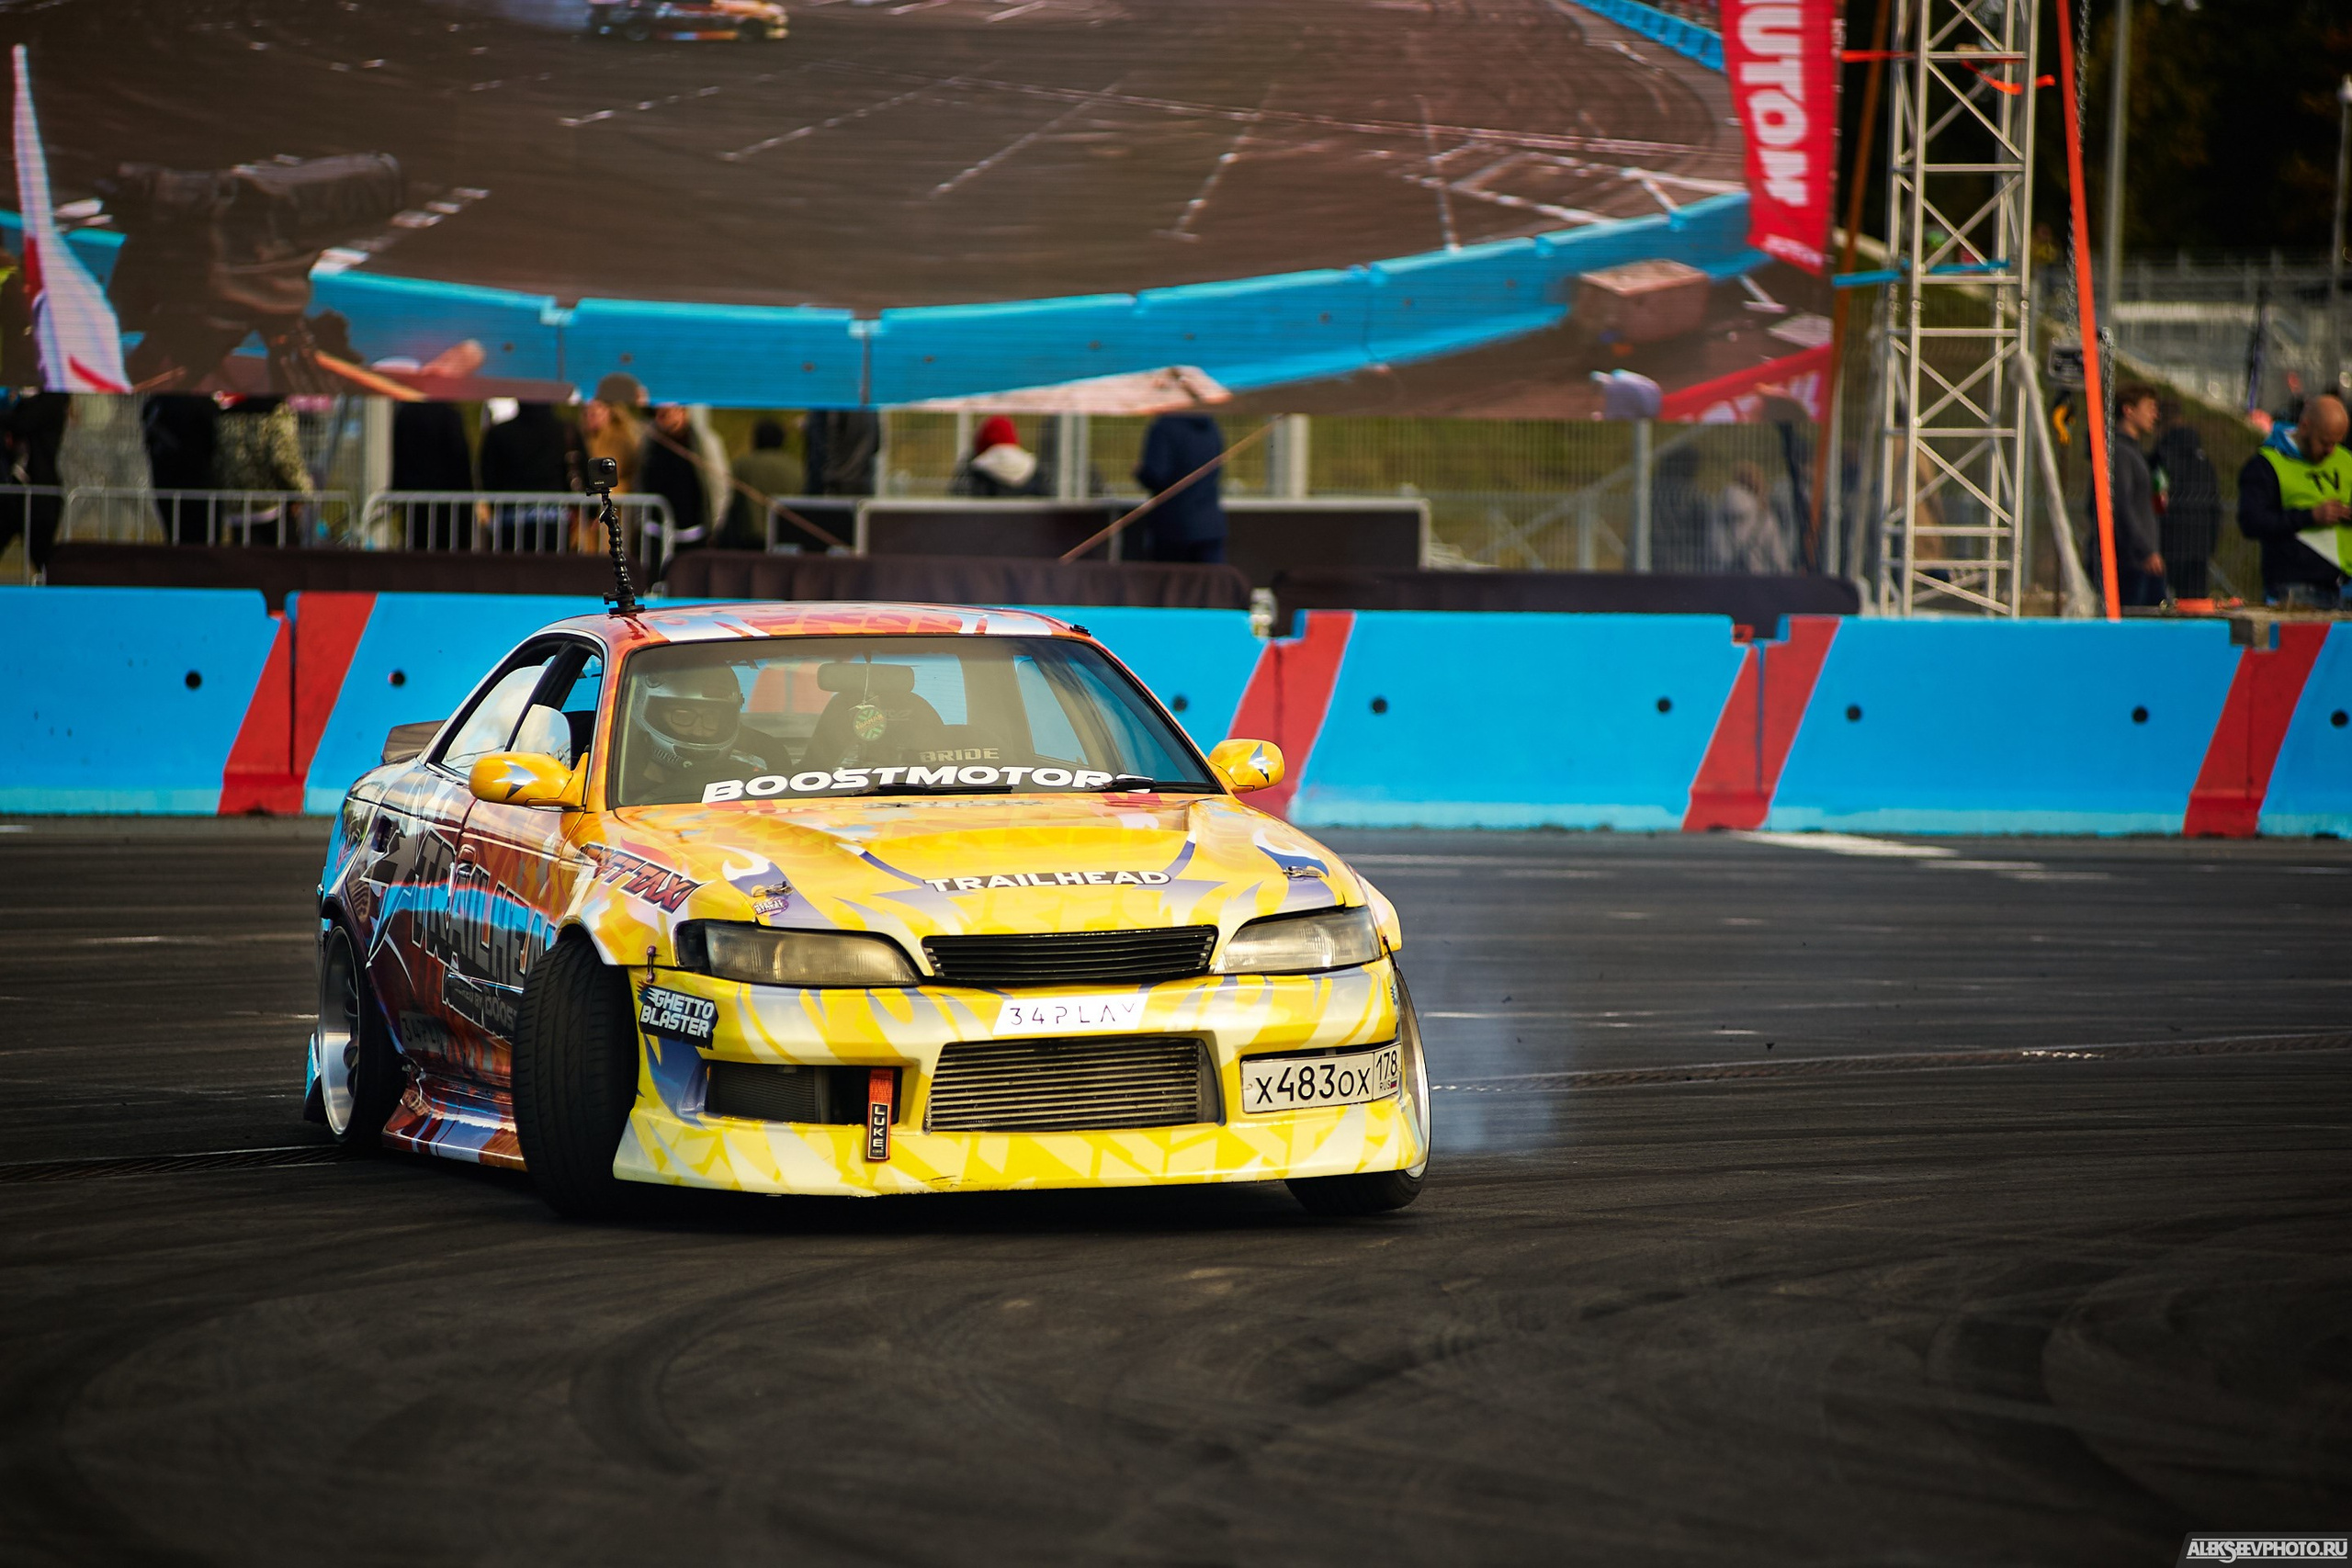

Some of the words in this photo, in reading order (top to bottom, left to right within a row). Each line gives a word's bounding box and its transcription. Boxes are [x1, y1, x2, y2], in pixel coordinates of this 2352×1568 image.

[2305, 468, 2340, 494] TV
[920, 748, 1000, 763] BRIDE
[621, 863, 700, 913] TAXI
[924, 871, 1170, 892] TRAILHEAD
[413, 827, 557, 989] TRAILHEA
[647, 987, 715, 1020] GHETTO
[639, 1004, 709, 1038] BLASTER
[1376, 1049, 1397, 1081] 178
[1379, 1082, 1391, 1090] RUS
